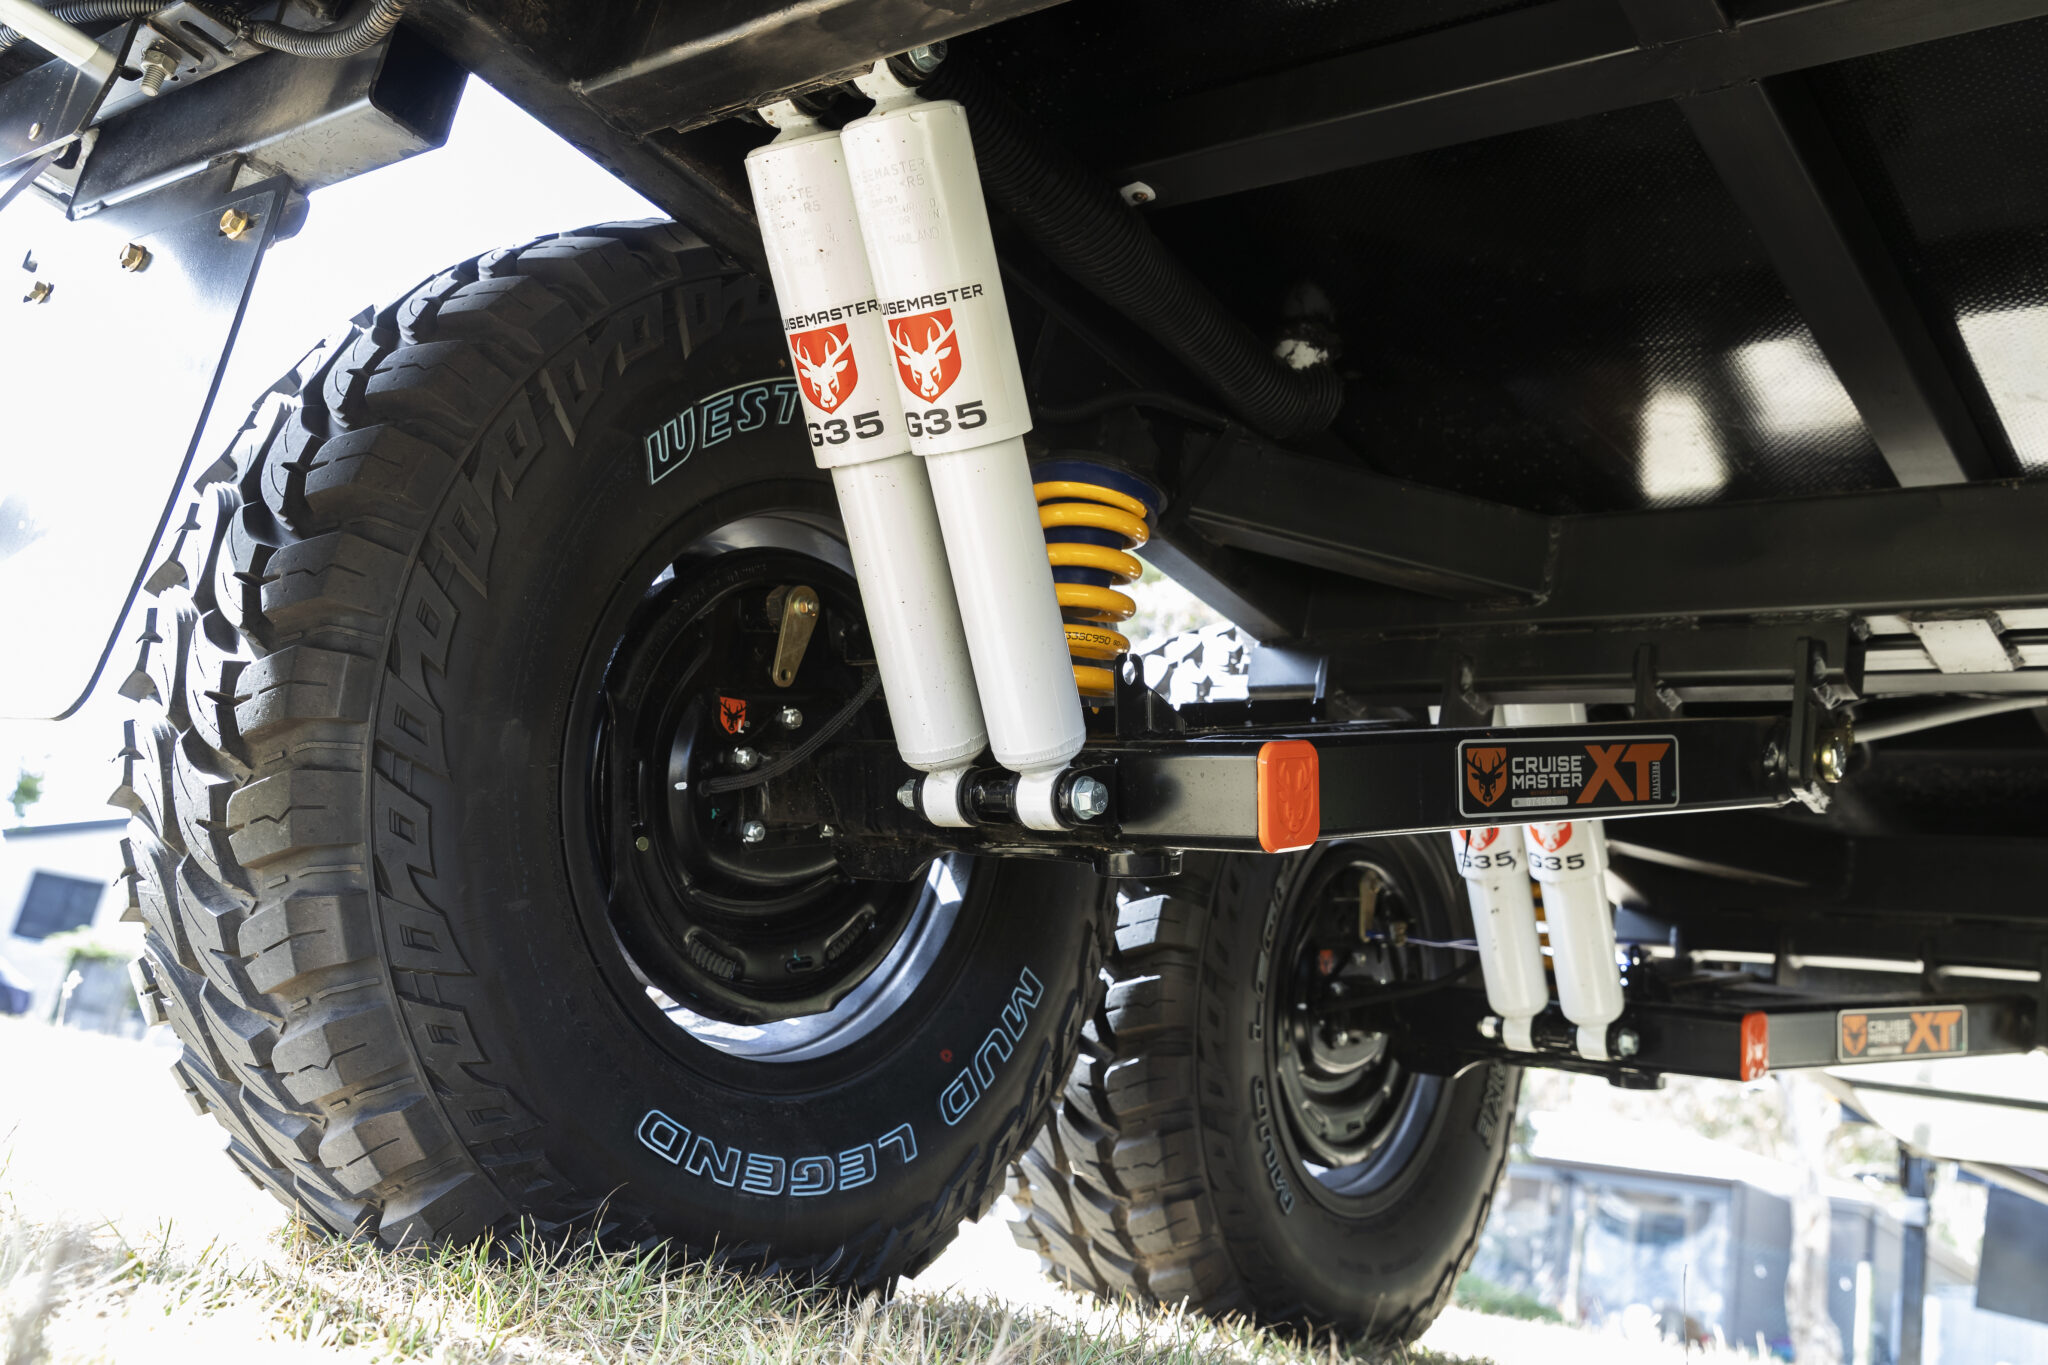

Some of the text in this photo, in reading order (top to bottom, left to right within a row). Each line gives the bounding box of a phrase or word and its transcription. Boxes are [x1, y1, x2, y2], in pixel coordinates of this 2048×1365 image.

[647, 384, 800, 485] WEST
[808, 410, 884, 447] G35
[905, 400, 987, 438] G35
[1511, 755, 1583, 773] CRUISE
[1511, 773, 1583, 790] MASTER
[1576, 743, 1671, 804] XT
[1528, 853, 1585, 871] G35
[1904, 1010, 1962, 1053] XT
[638, 966, 1045, 1197] MUD LEGEND
